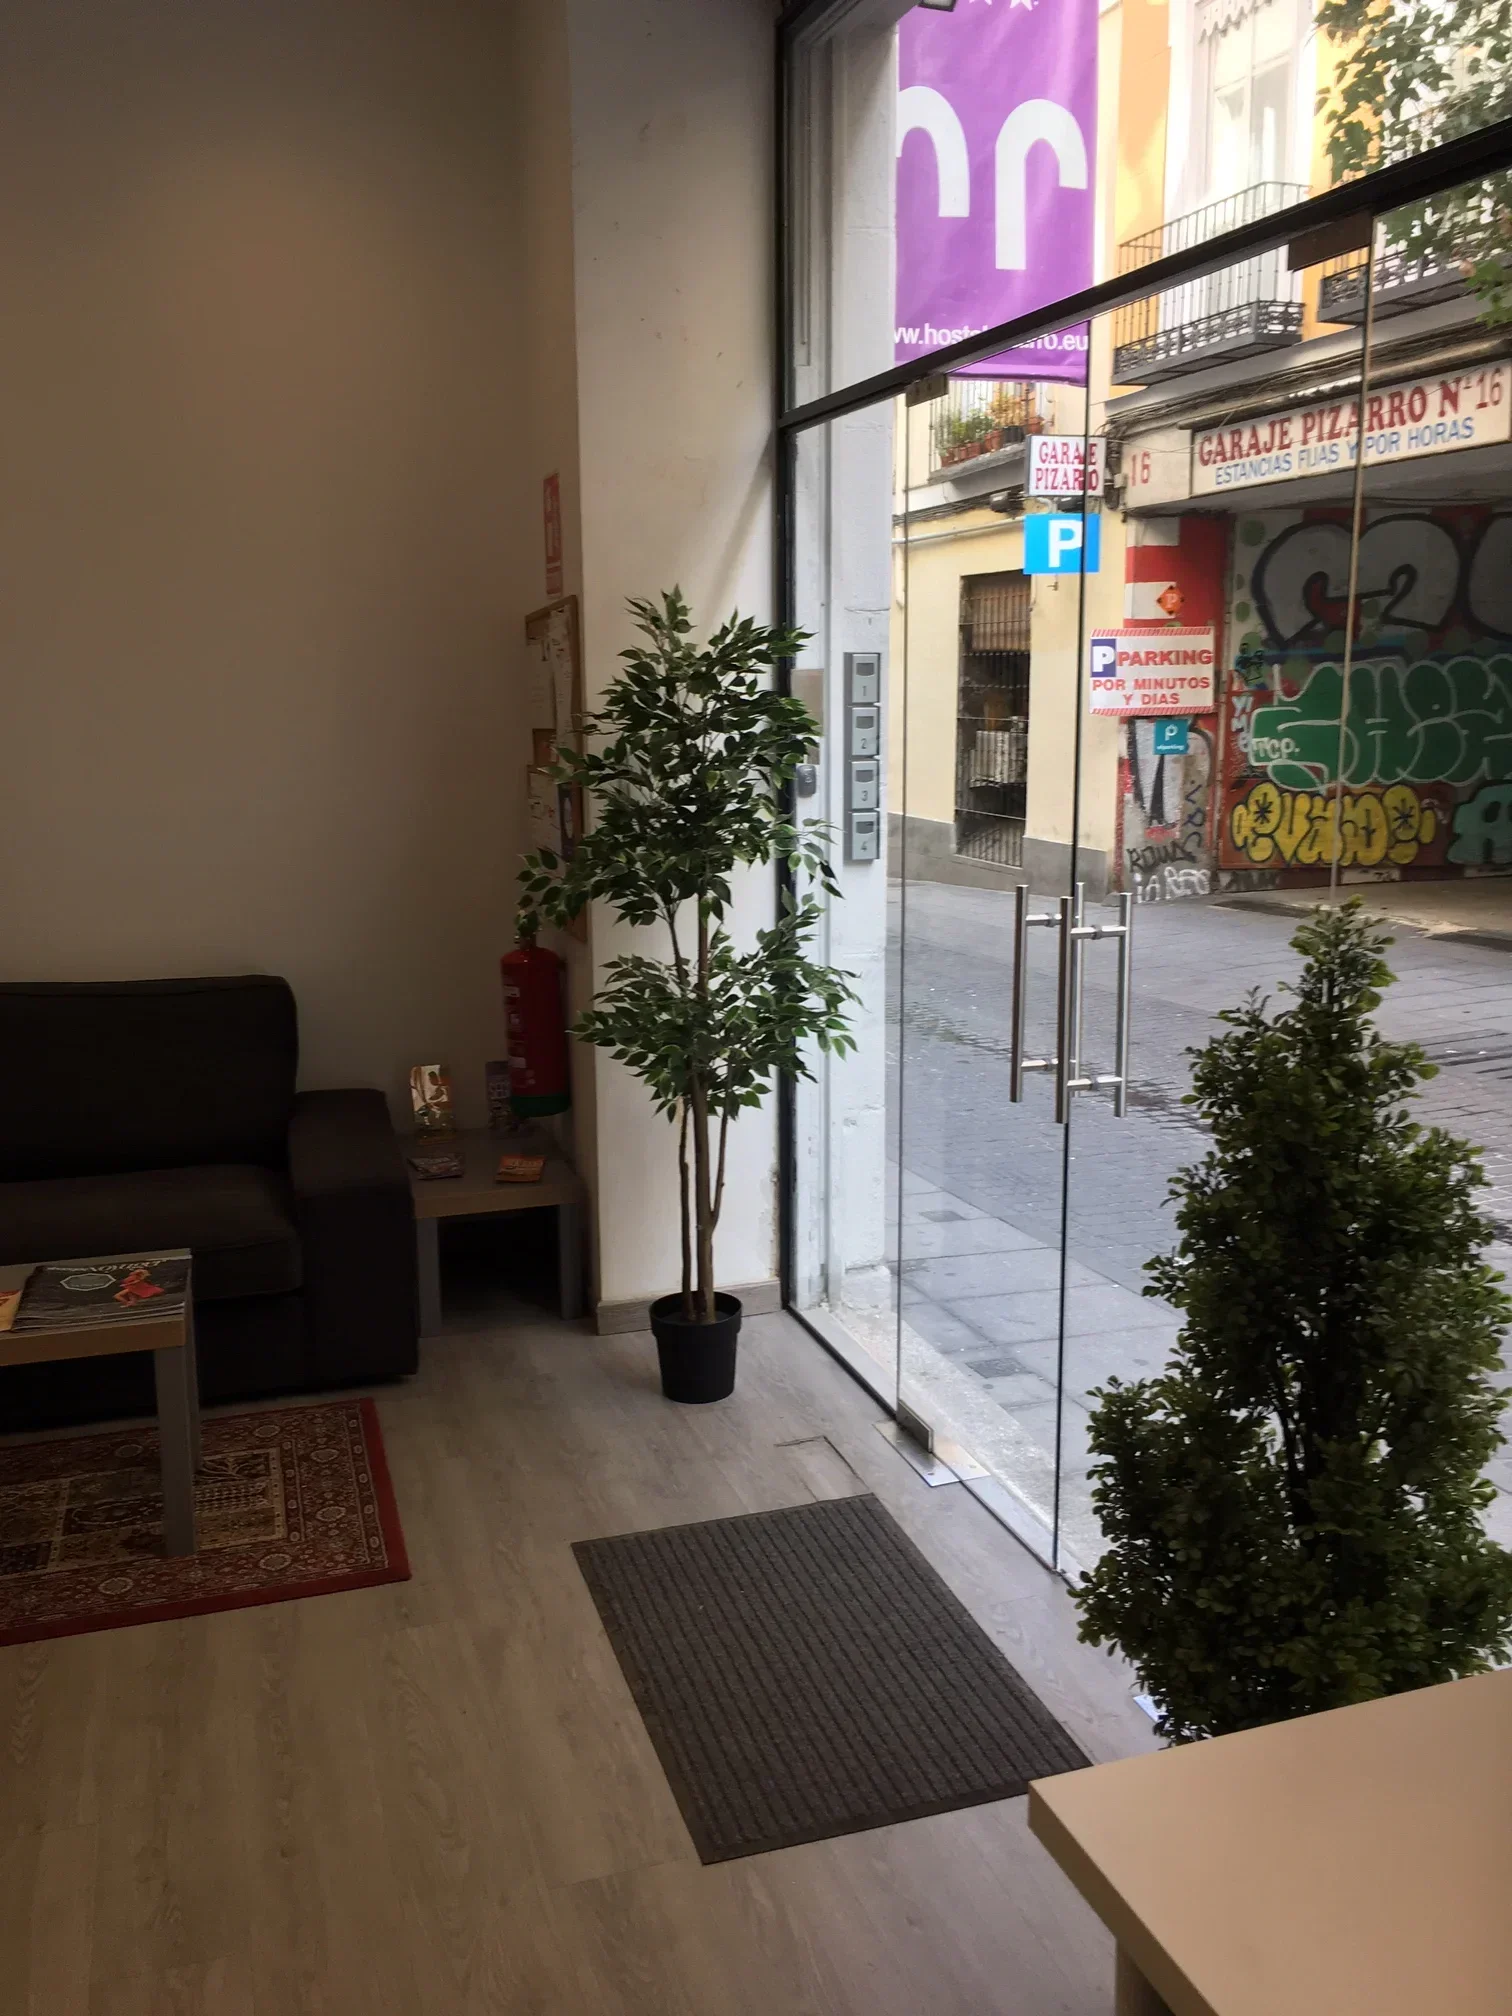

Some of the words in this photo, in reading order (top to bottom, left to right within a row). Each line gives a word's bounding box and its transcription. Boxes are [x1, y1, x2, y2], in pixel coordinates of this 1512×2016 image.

[1199, 416, 1292, 466] GARAJE
[1301, 385, 1427, 446] PIZARRO
[1476, 367, 1505, 409] 16
[1215, 452, 1293, 485] ESTANCIAS
[1363, 431, 1401, 458] POR
[1407, 416, 1475, 450] HORAS
[1131, 451, 1150, 487] 16
[1048, 519, 1083, 568] P
[1092, 645, 1115, 673] P
[1117, 649, 1213, 667] PARKING
[861, 686, 867, 696] 1
[1092, 678, 1126, 691] POR
[1134, 676, 1210, 690] MINUTOS
[1123, 694, 1133, 705] Y
[1141, 692, 1180, 705] DIAS
[861, 738, 867, 749] 2
